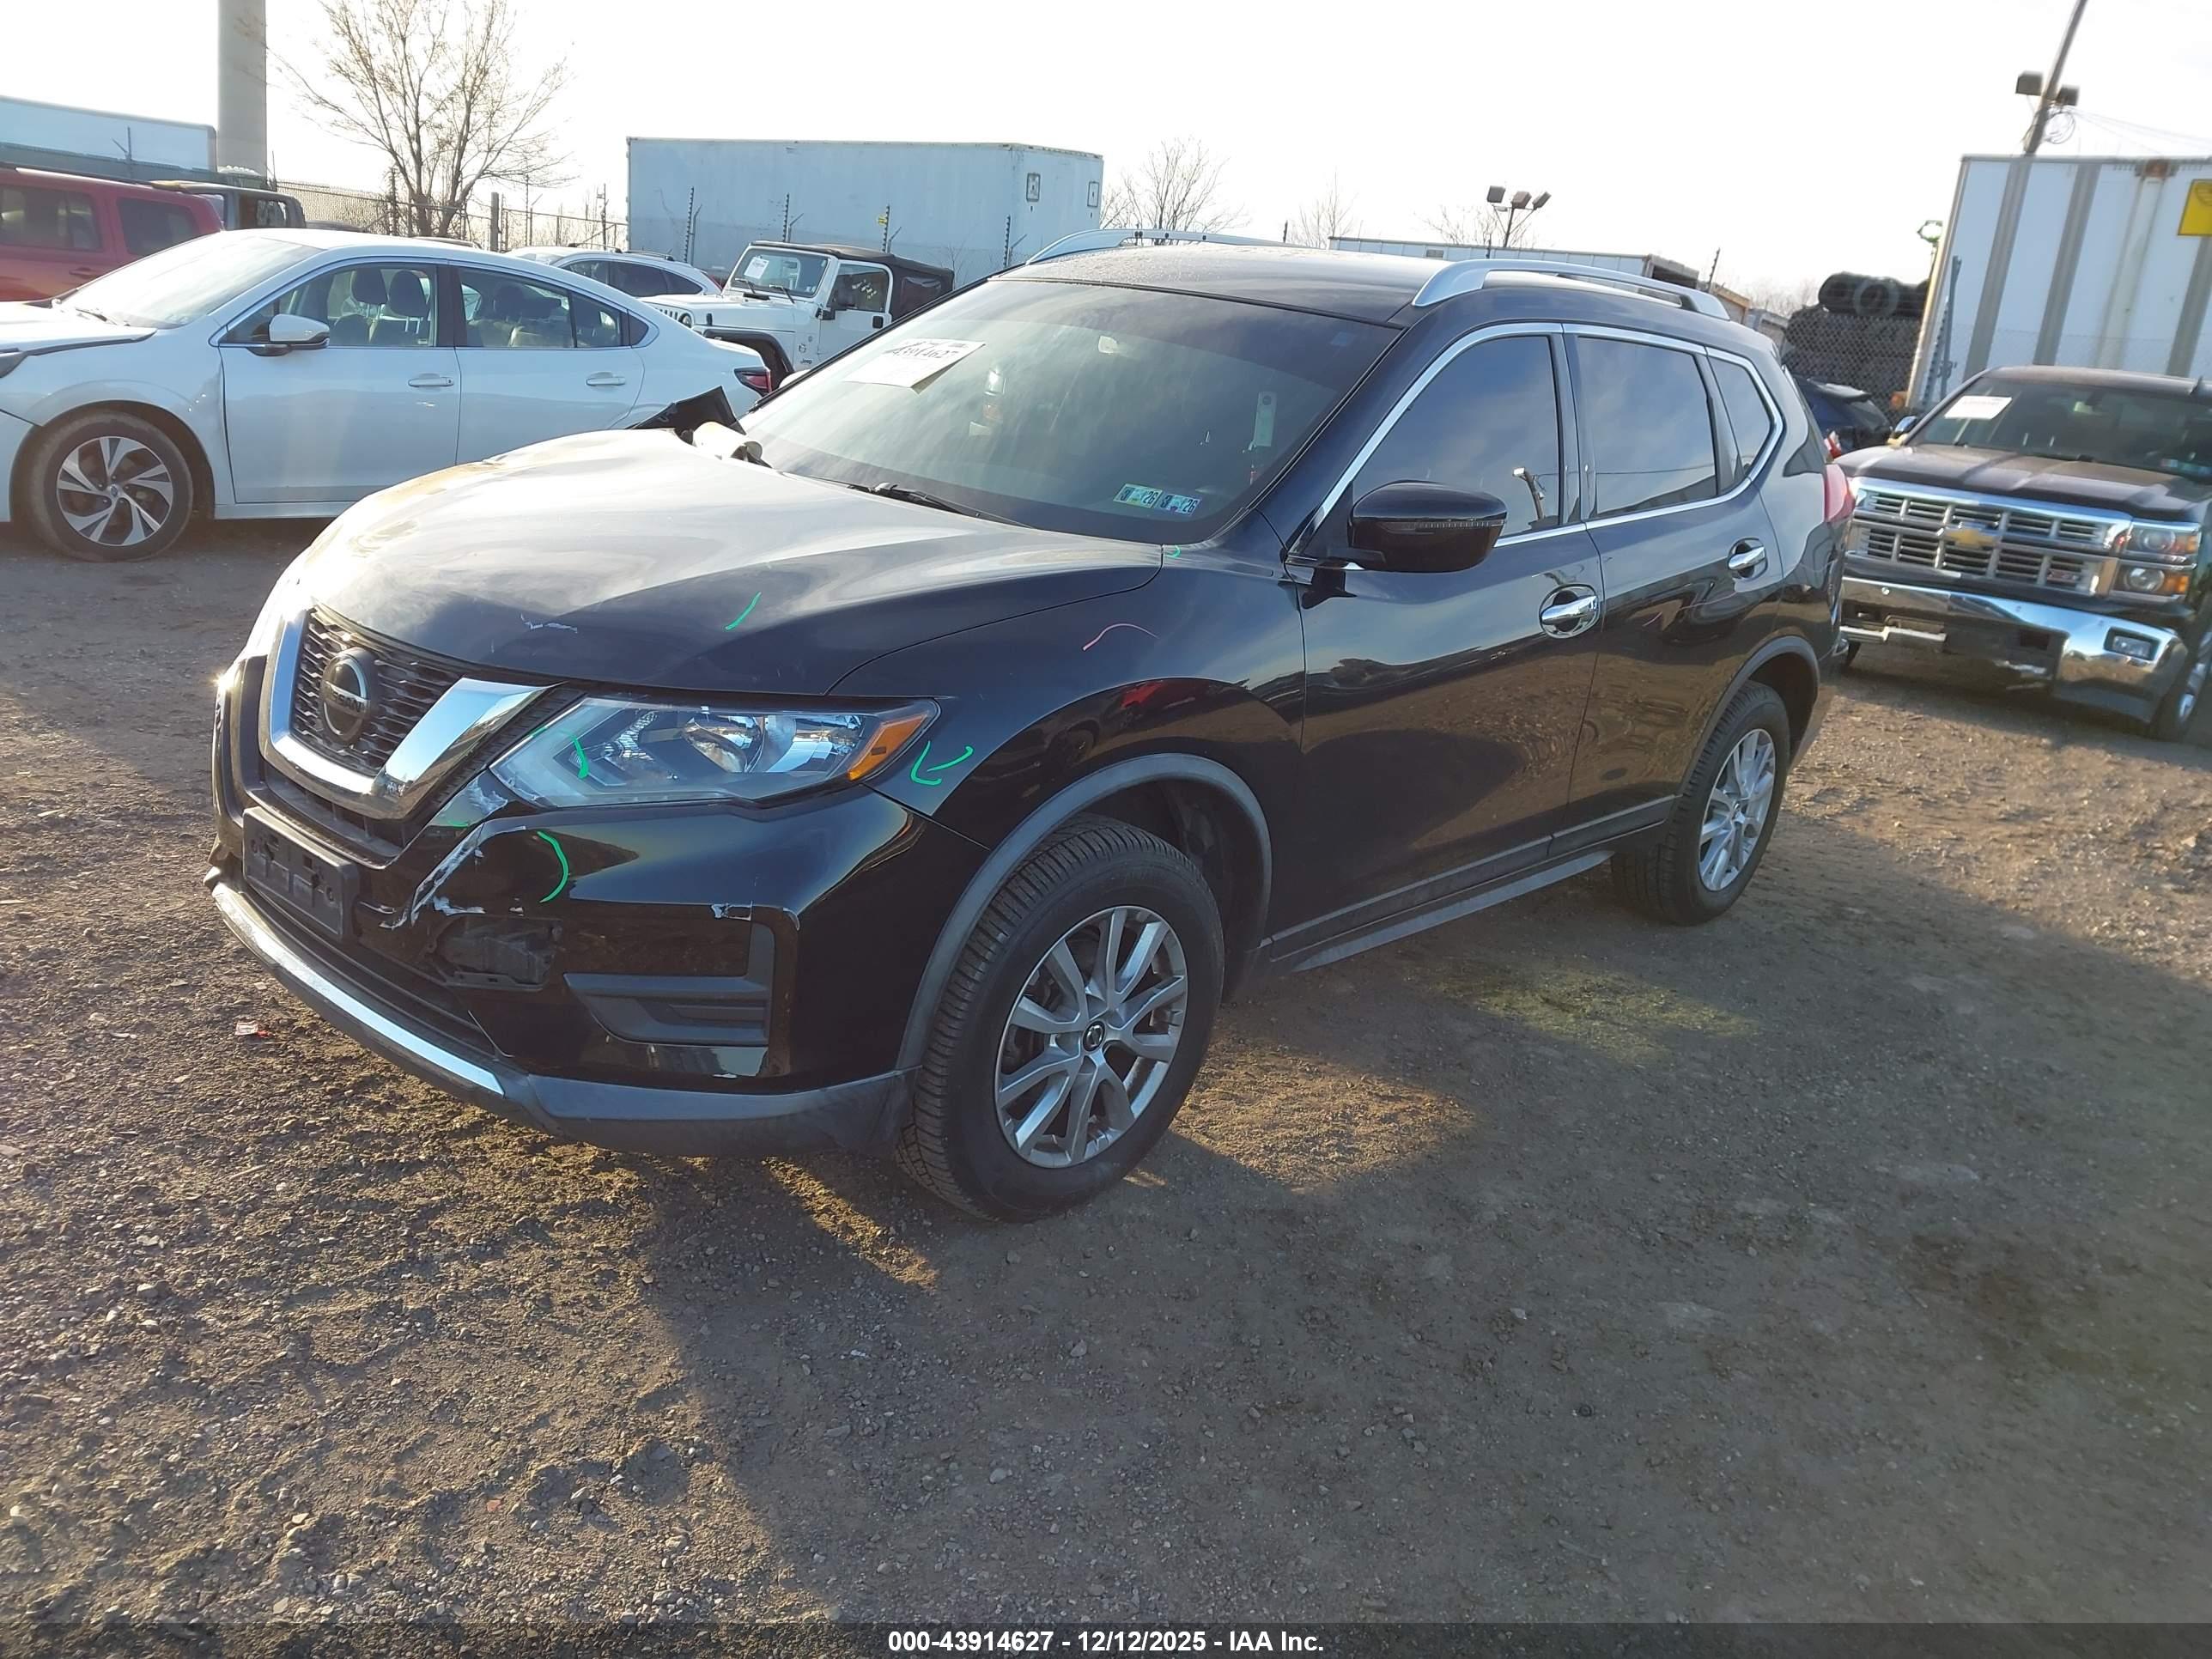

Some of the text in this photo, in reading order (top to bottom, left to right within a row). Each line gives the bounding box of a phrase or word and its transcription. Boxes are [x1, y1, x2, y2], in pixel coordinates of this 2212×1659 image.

[1120, 489, 1131, 501] 3
[1160, 495, 1198, 513] 3 26
